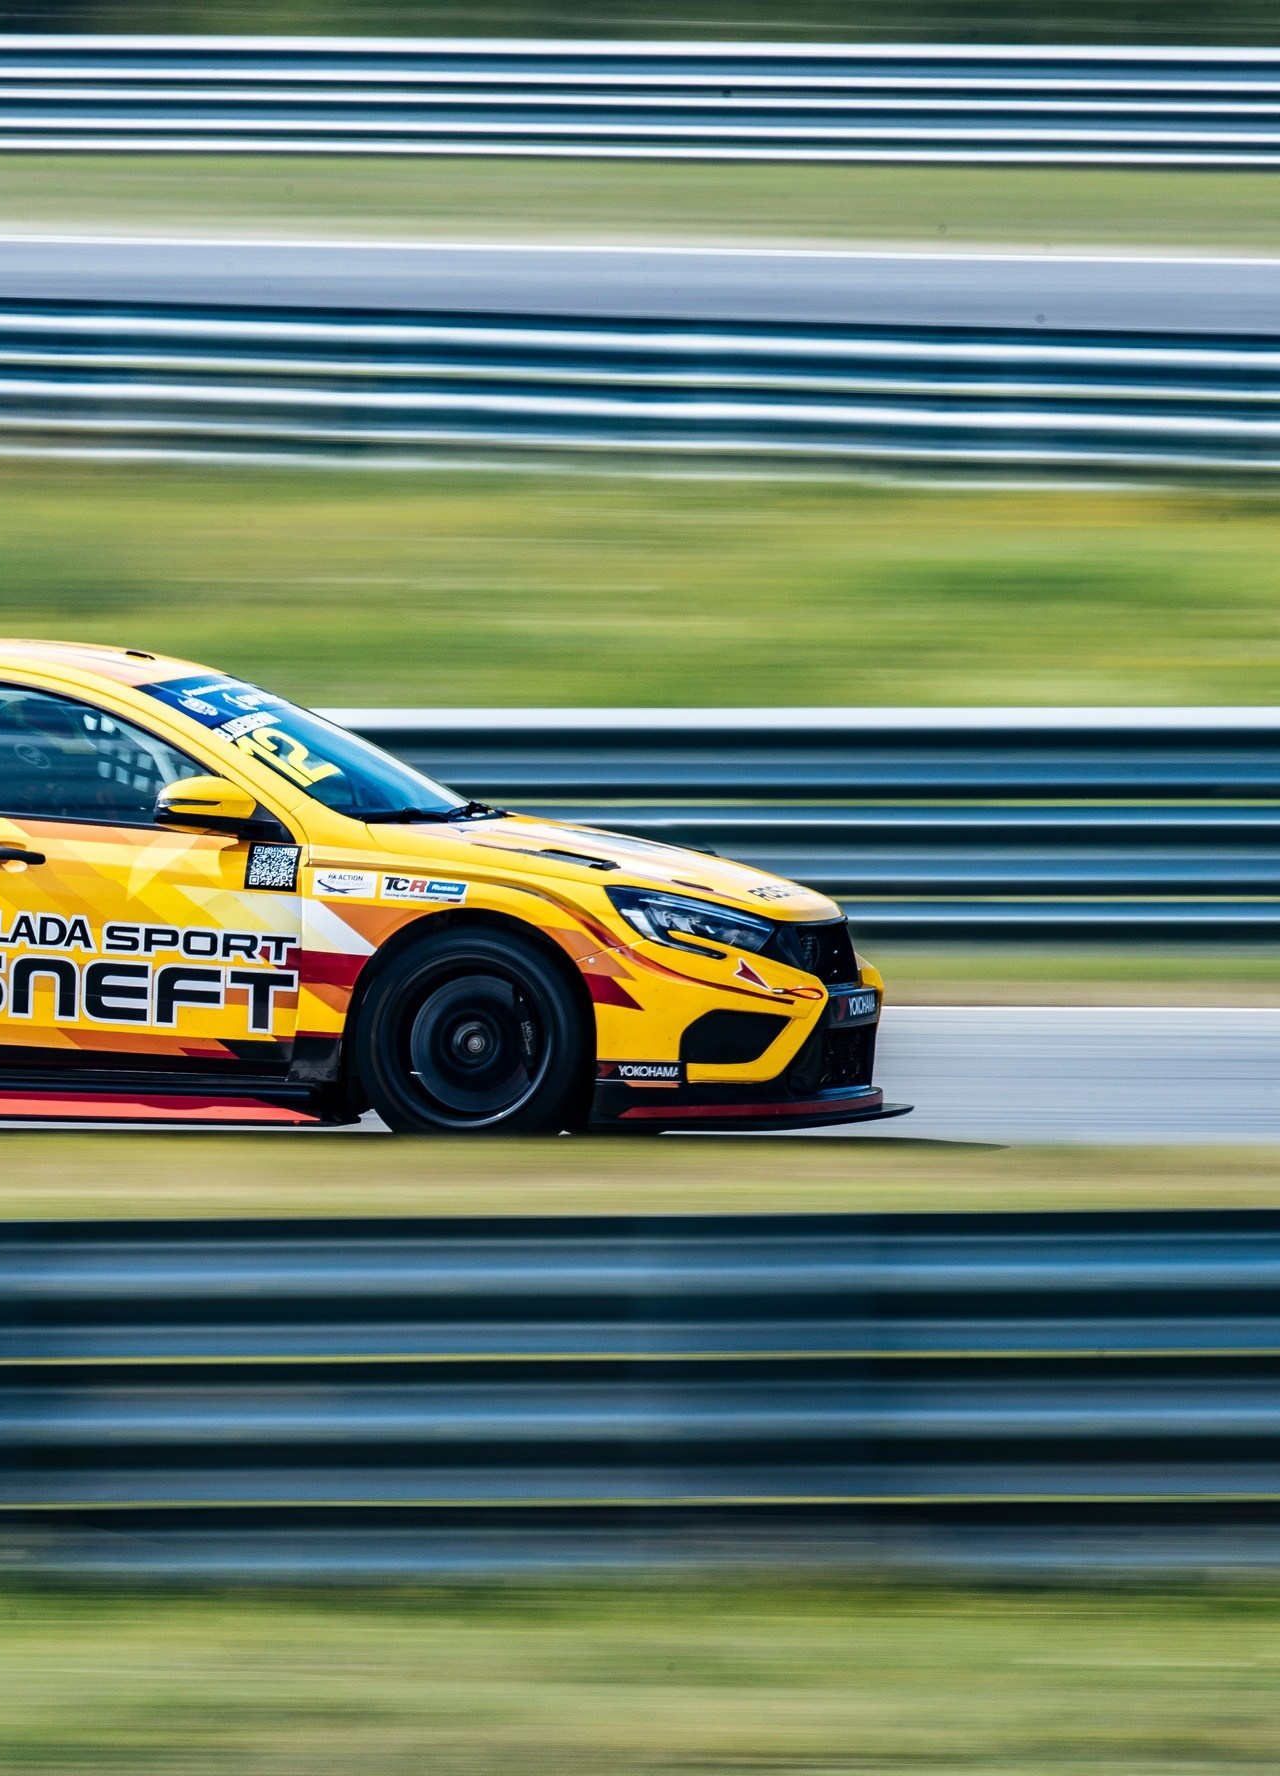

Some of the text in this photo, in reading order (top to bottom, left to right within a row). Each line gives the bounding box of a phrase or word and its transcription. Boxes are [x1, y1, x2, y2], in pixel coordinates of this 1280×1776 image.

[235, 727, 339, 788] 12
[385, 877, 428, 893] TCR
[431, 884, 459, 892] Russia
[103, 922, 299, 964] SPORT
[848, 992, 876, 1016] YOKOHAMA
[618, 1065, 679, 1077] YOKOHAMA
